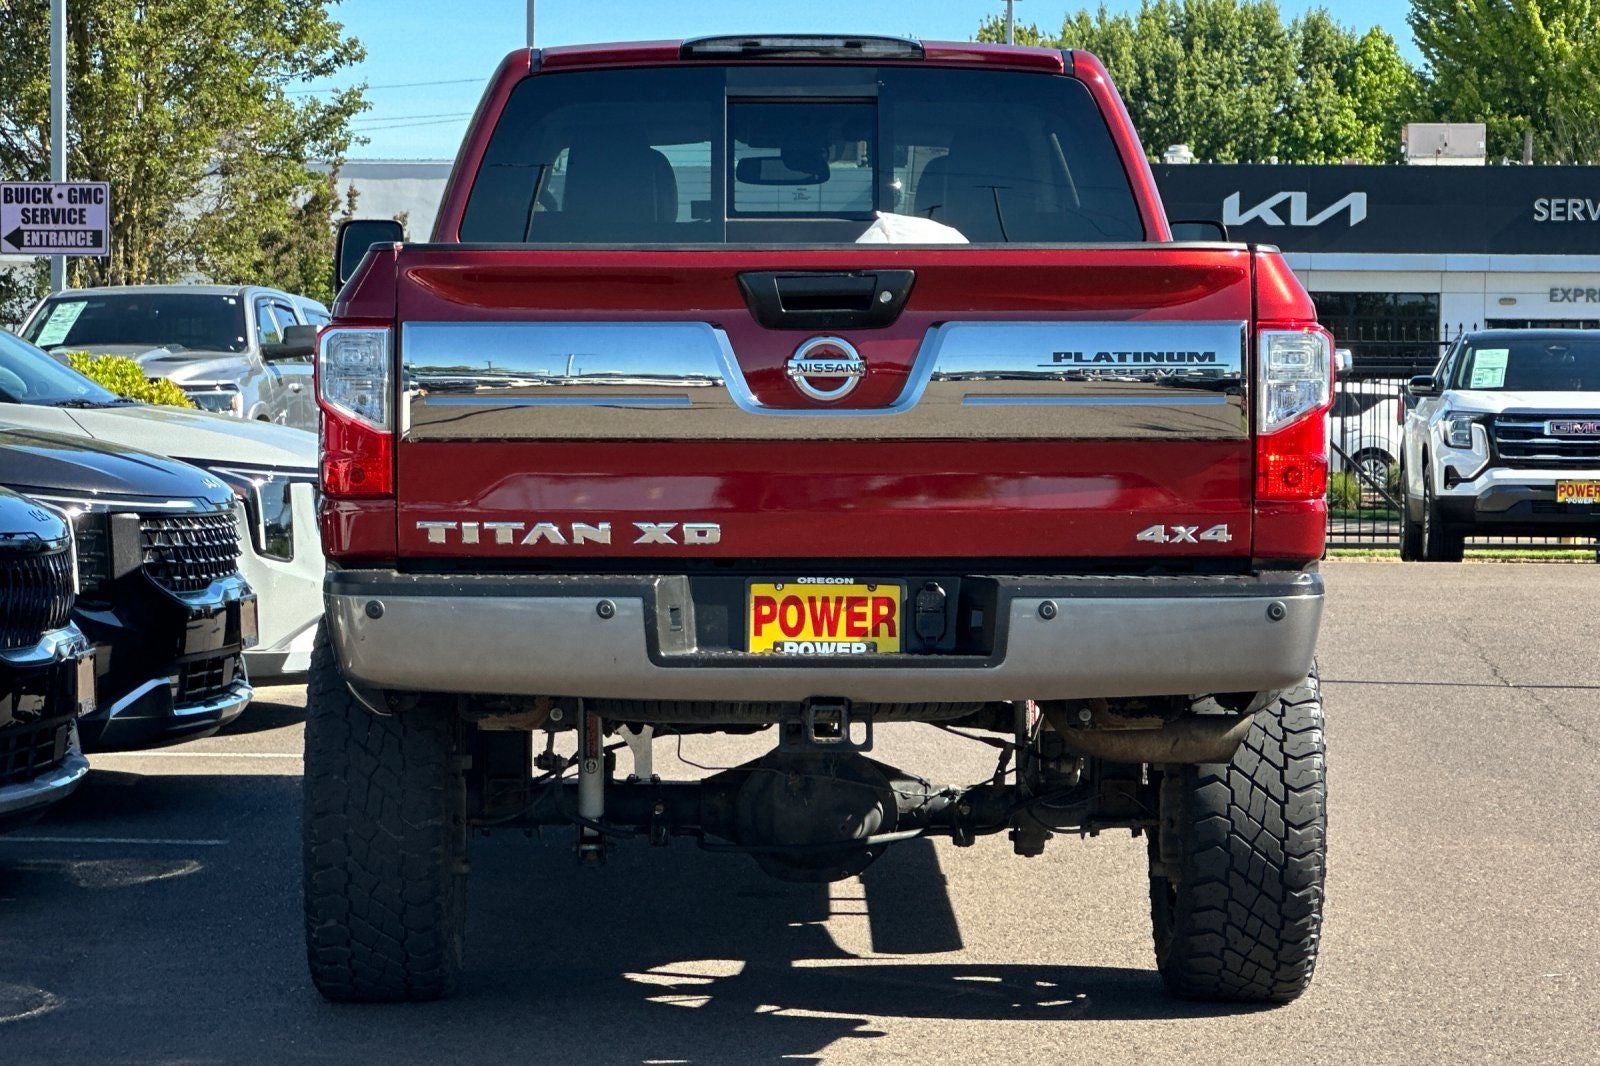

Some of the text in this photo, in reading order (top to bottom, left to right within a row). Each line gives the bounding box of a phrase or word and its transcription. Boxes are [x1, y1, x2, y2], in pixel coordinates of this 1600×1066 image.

[3, 187, 104, 204] BUICK GMC
[21, 207, 87, 225] SERVICE
[1223, 191, 1367, 227] KIA
[1534, 198, 1600, 221] SERV
[23, 231, 93, 246] ENTRANCE
[1052, 351, 1216, 363] PLATINUM
[796, 363, 857, 373] NISSAN
[1080, 368, 1188, 377] RESERVE
[416, 521, 721, 545] TITAN XD
[797, 577, 854, 585] OREGON
[753, 594, 897, 638] POWER
